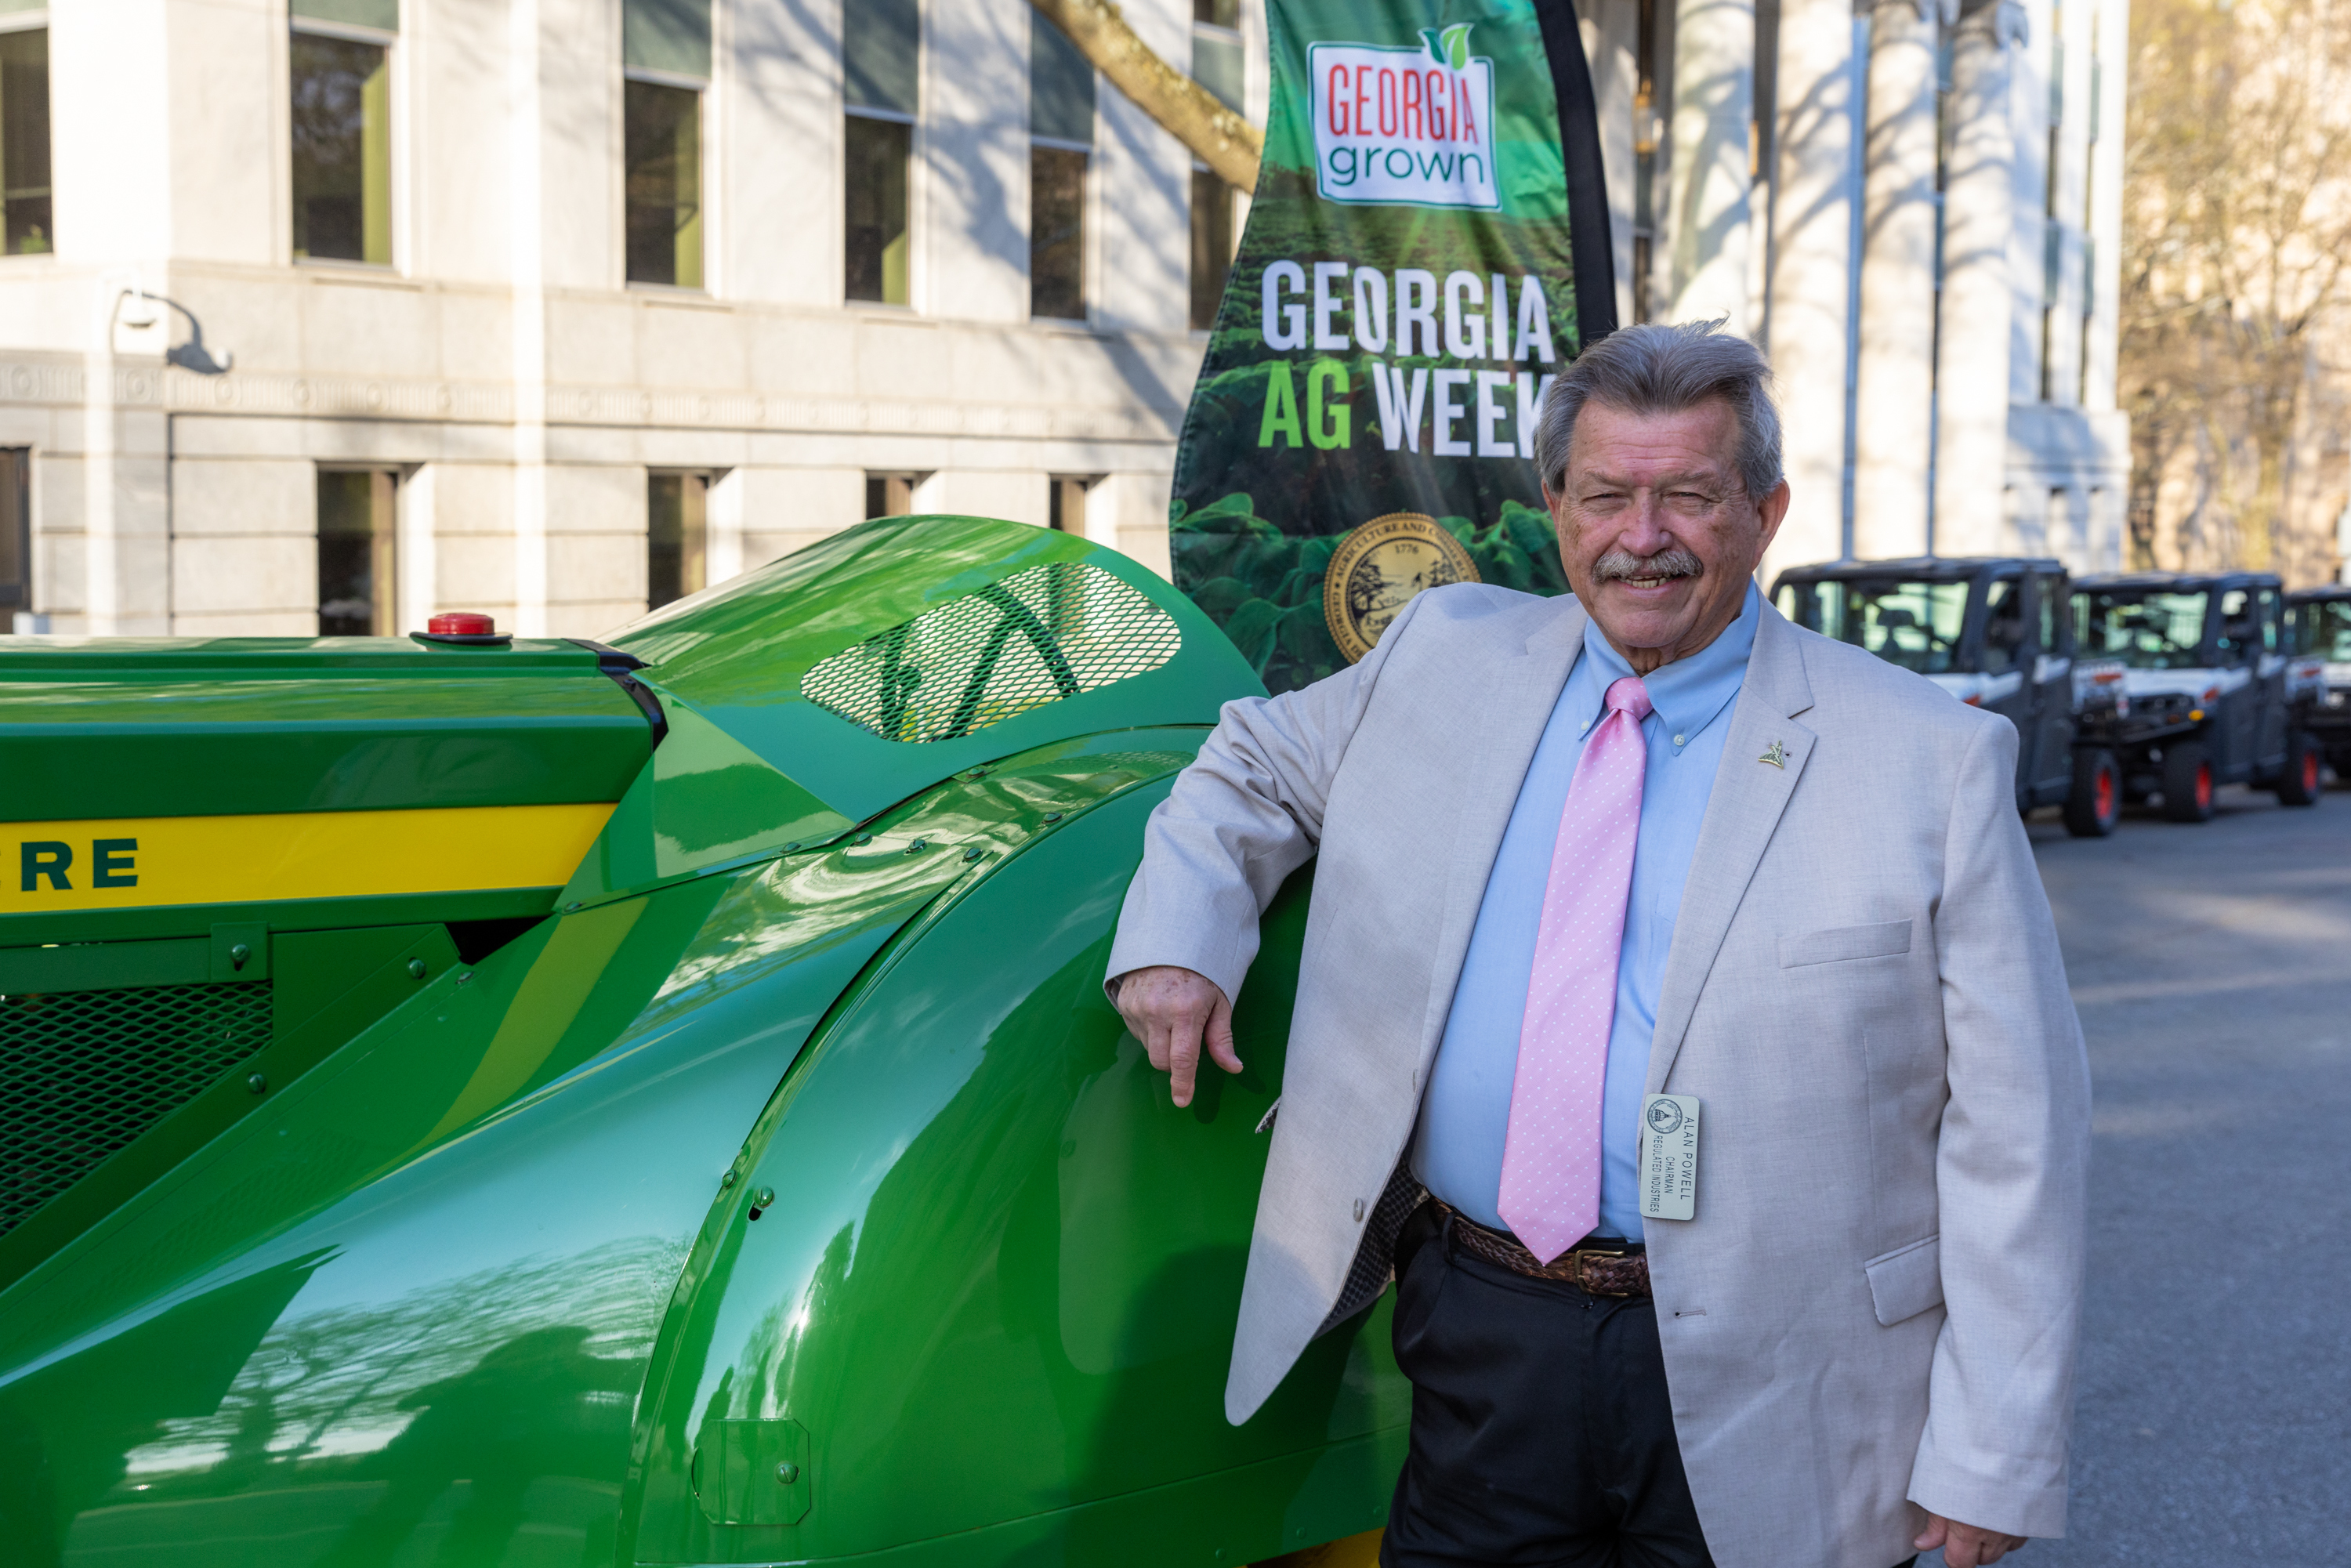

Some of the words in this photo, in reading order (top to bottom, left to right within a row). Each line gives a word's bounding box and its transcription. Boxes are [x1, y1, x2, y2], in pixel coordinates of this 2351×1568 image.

[1328, 63, 1479, 145] GEORGIA
[1329, 147, 1483, 186] grown
[1261, 259, 1556, 364] GEORGIA
[1258, 359, 1351, 451] AG
[1403, 522, 1427, 534] AND
[0, 838, 139, 893] RE
[1683, 1116, 1695, 1147] ALAN
[1652, 1135, 1664, 1173] REGULATED
[1650, 1174, 1661, 1213] INDUSTRIES
[1664, 1156, 1675, 1194] CHAIRMAN
[1680, 1153, 1694, 1200] POWELL
